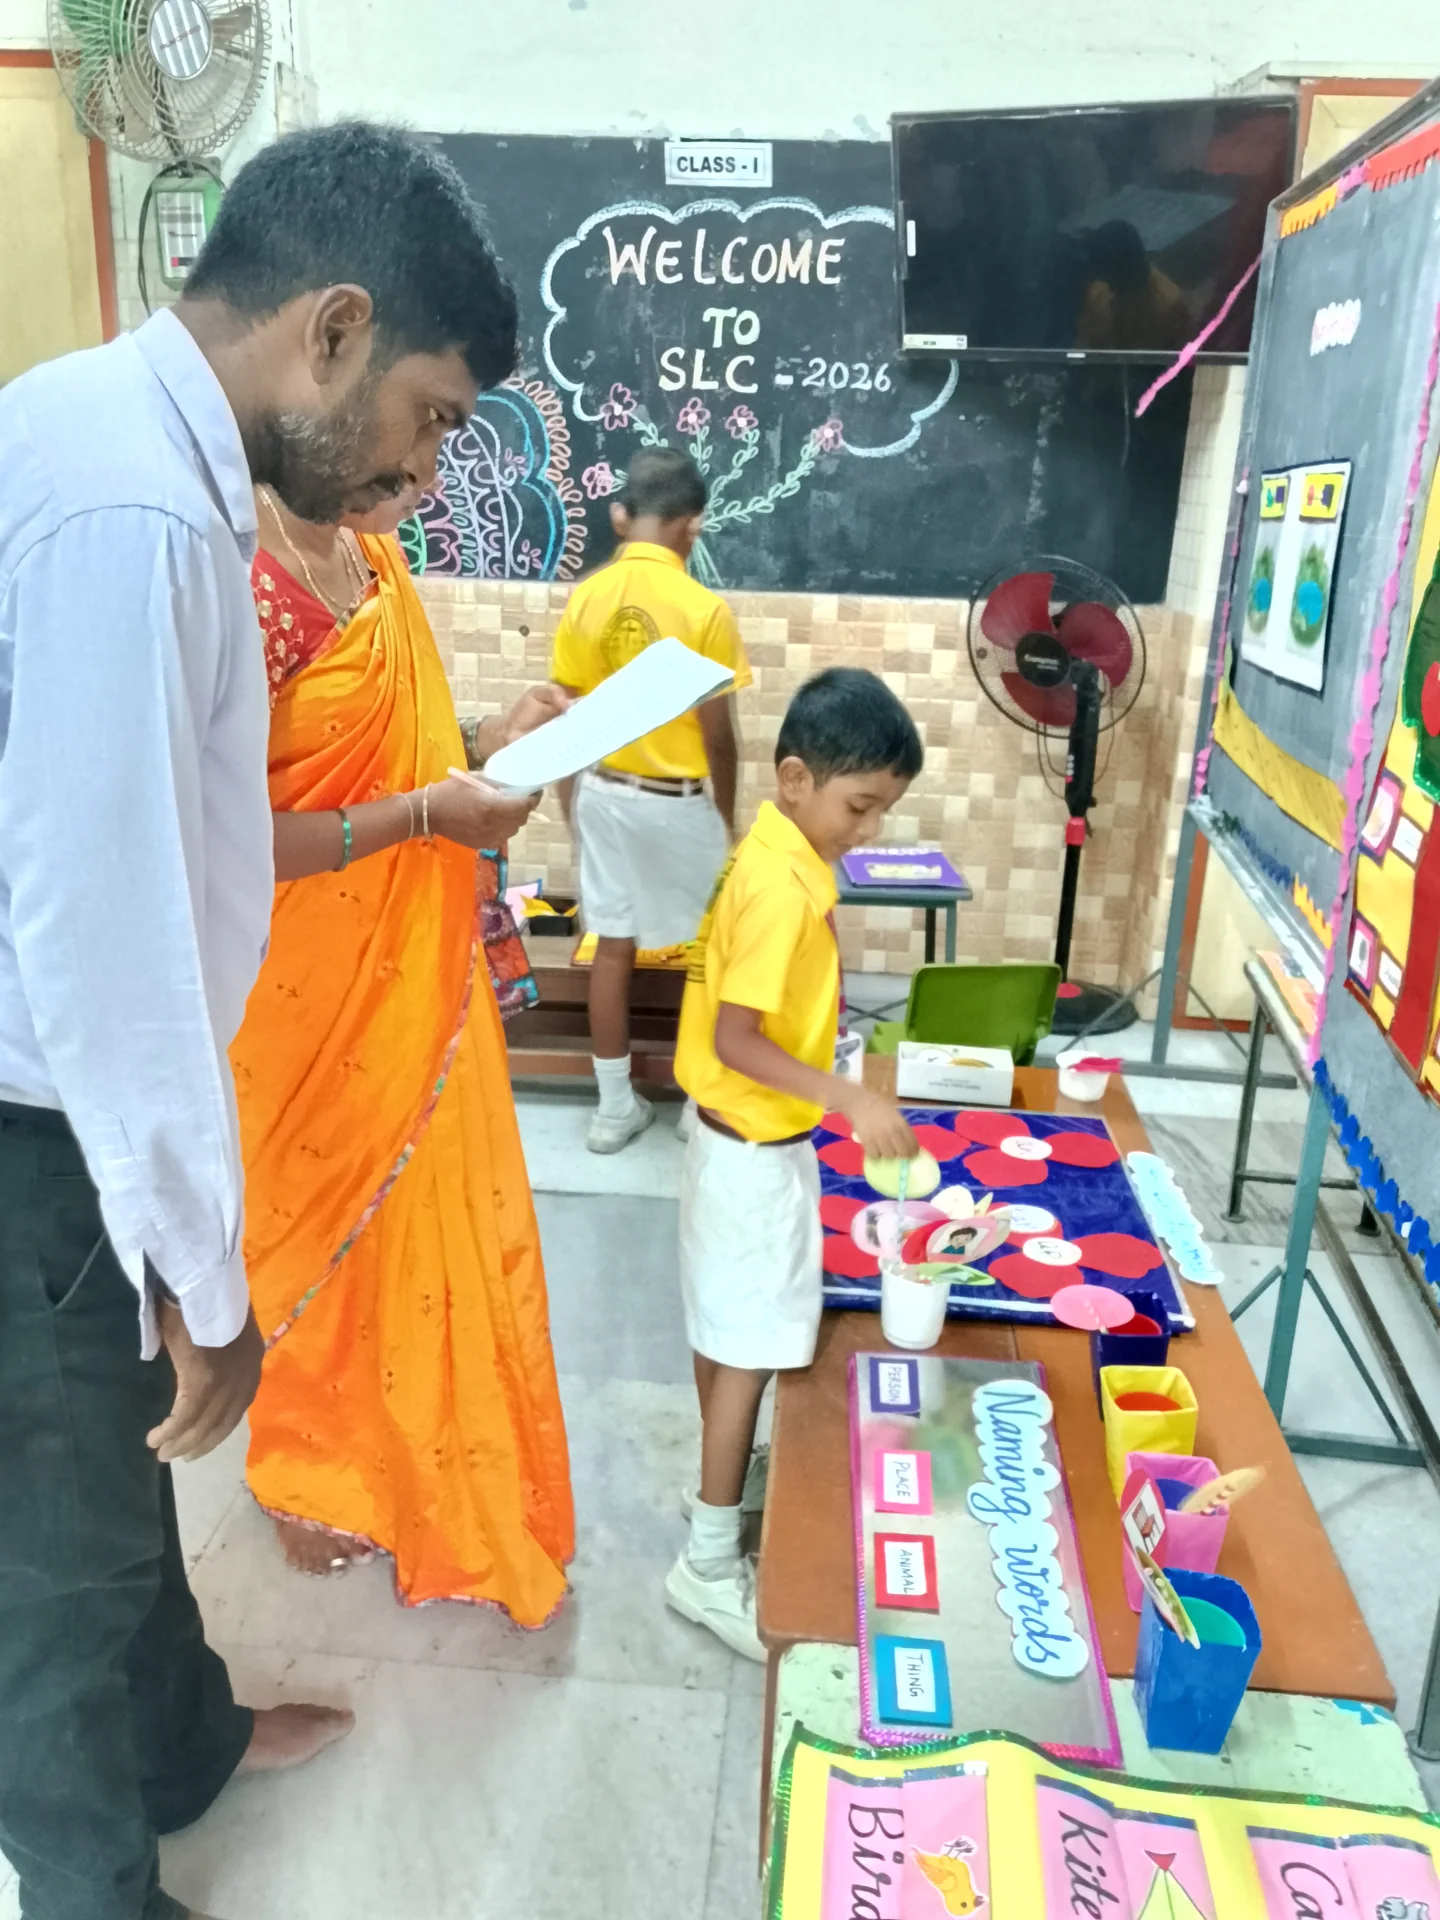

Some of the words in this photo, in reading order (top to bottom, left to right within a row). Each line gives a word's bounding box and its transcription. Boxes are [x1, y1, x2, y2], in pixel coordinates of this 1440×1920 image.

[677, 156, 735, 172] CLASS
[602, 226, 845, 285] WELCOME
[702, 307, 760, 348] TO
[658, 347, 758, 393] SLC
[887, 1366, 902, 1402] PERSON
[893, 1460, 911, 1497] PLACE
[970, 1391, 1042, 1524] Naming
[899, 1549, 914, 1594] ANIMAL
[907, 1653, 924, 1697] THING
[1058, 1810, 1120, 1920] Kite
